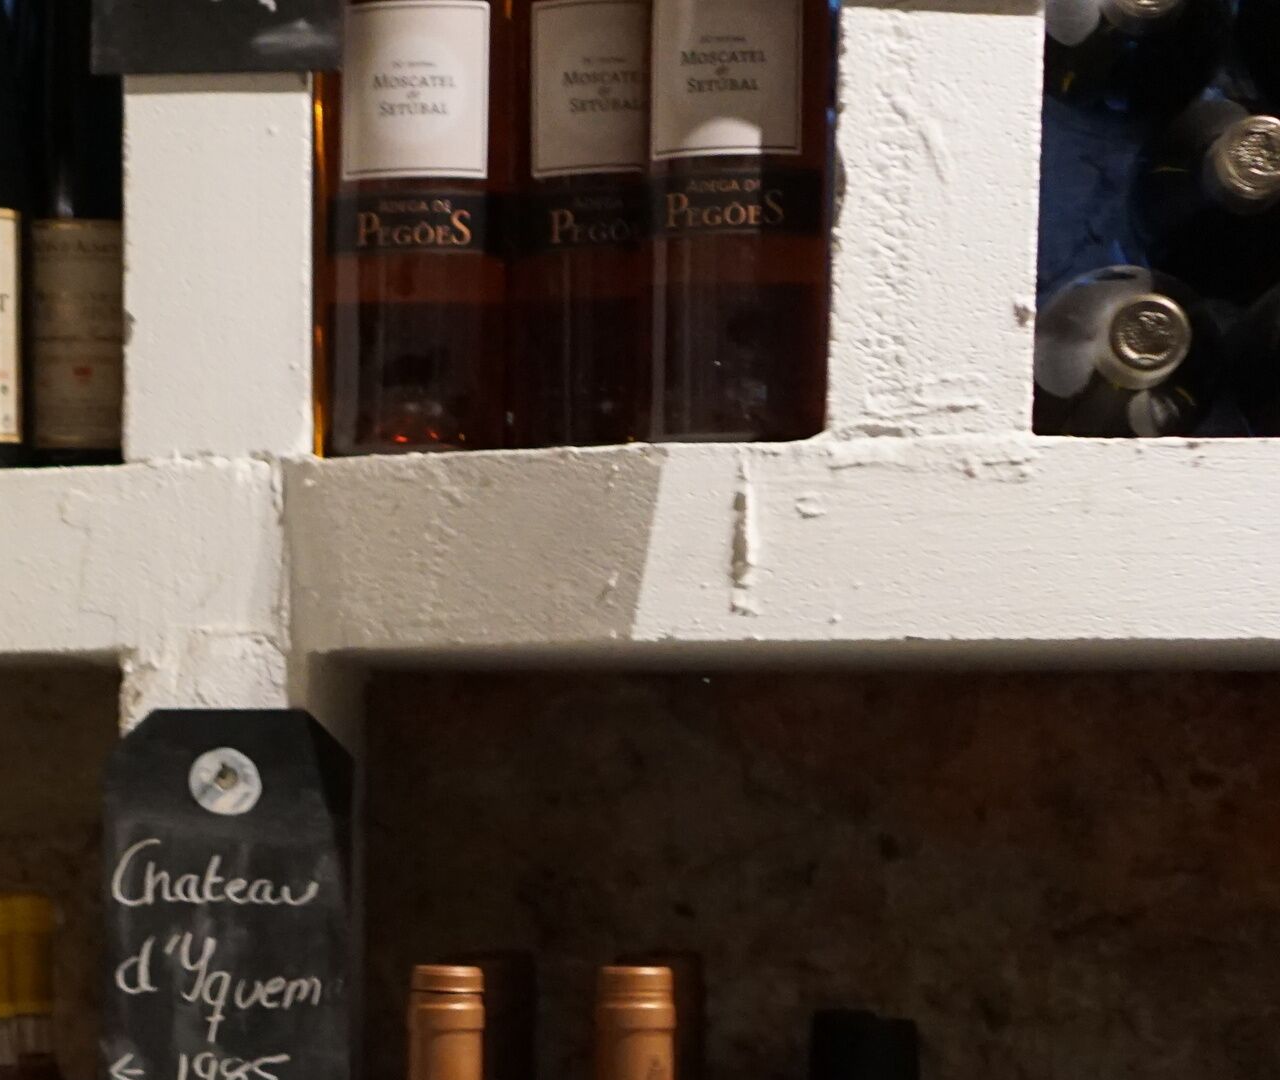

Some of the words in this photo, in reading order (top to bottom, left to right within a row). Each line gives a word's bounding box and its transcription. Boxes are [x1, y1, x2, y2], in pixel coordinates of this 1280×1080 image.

[680, 50, 767, 66] MOSCATEL
[373, 72, 456, 90] MOSCATEL
[563, 70, 646, 88] MOSCATE
[111, 837, 320, 907] Chateau
[114, 931, 322, 1044] d'Yquem
